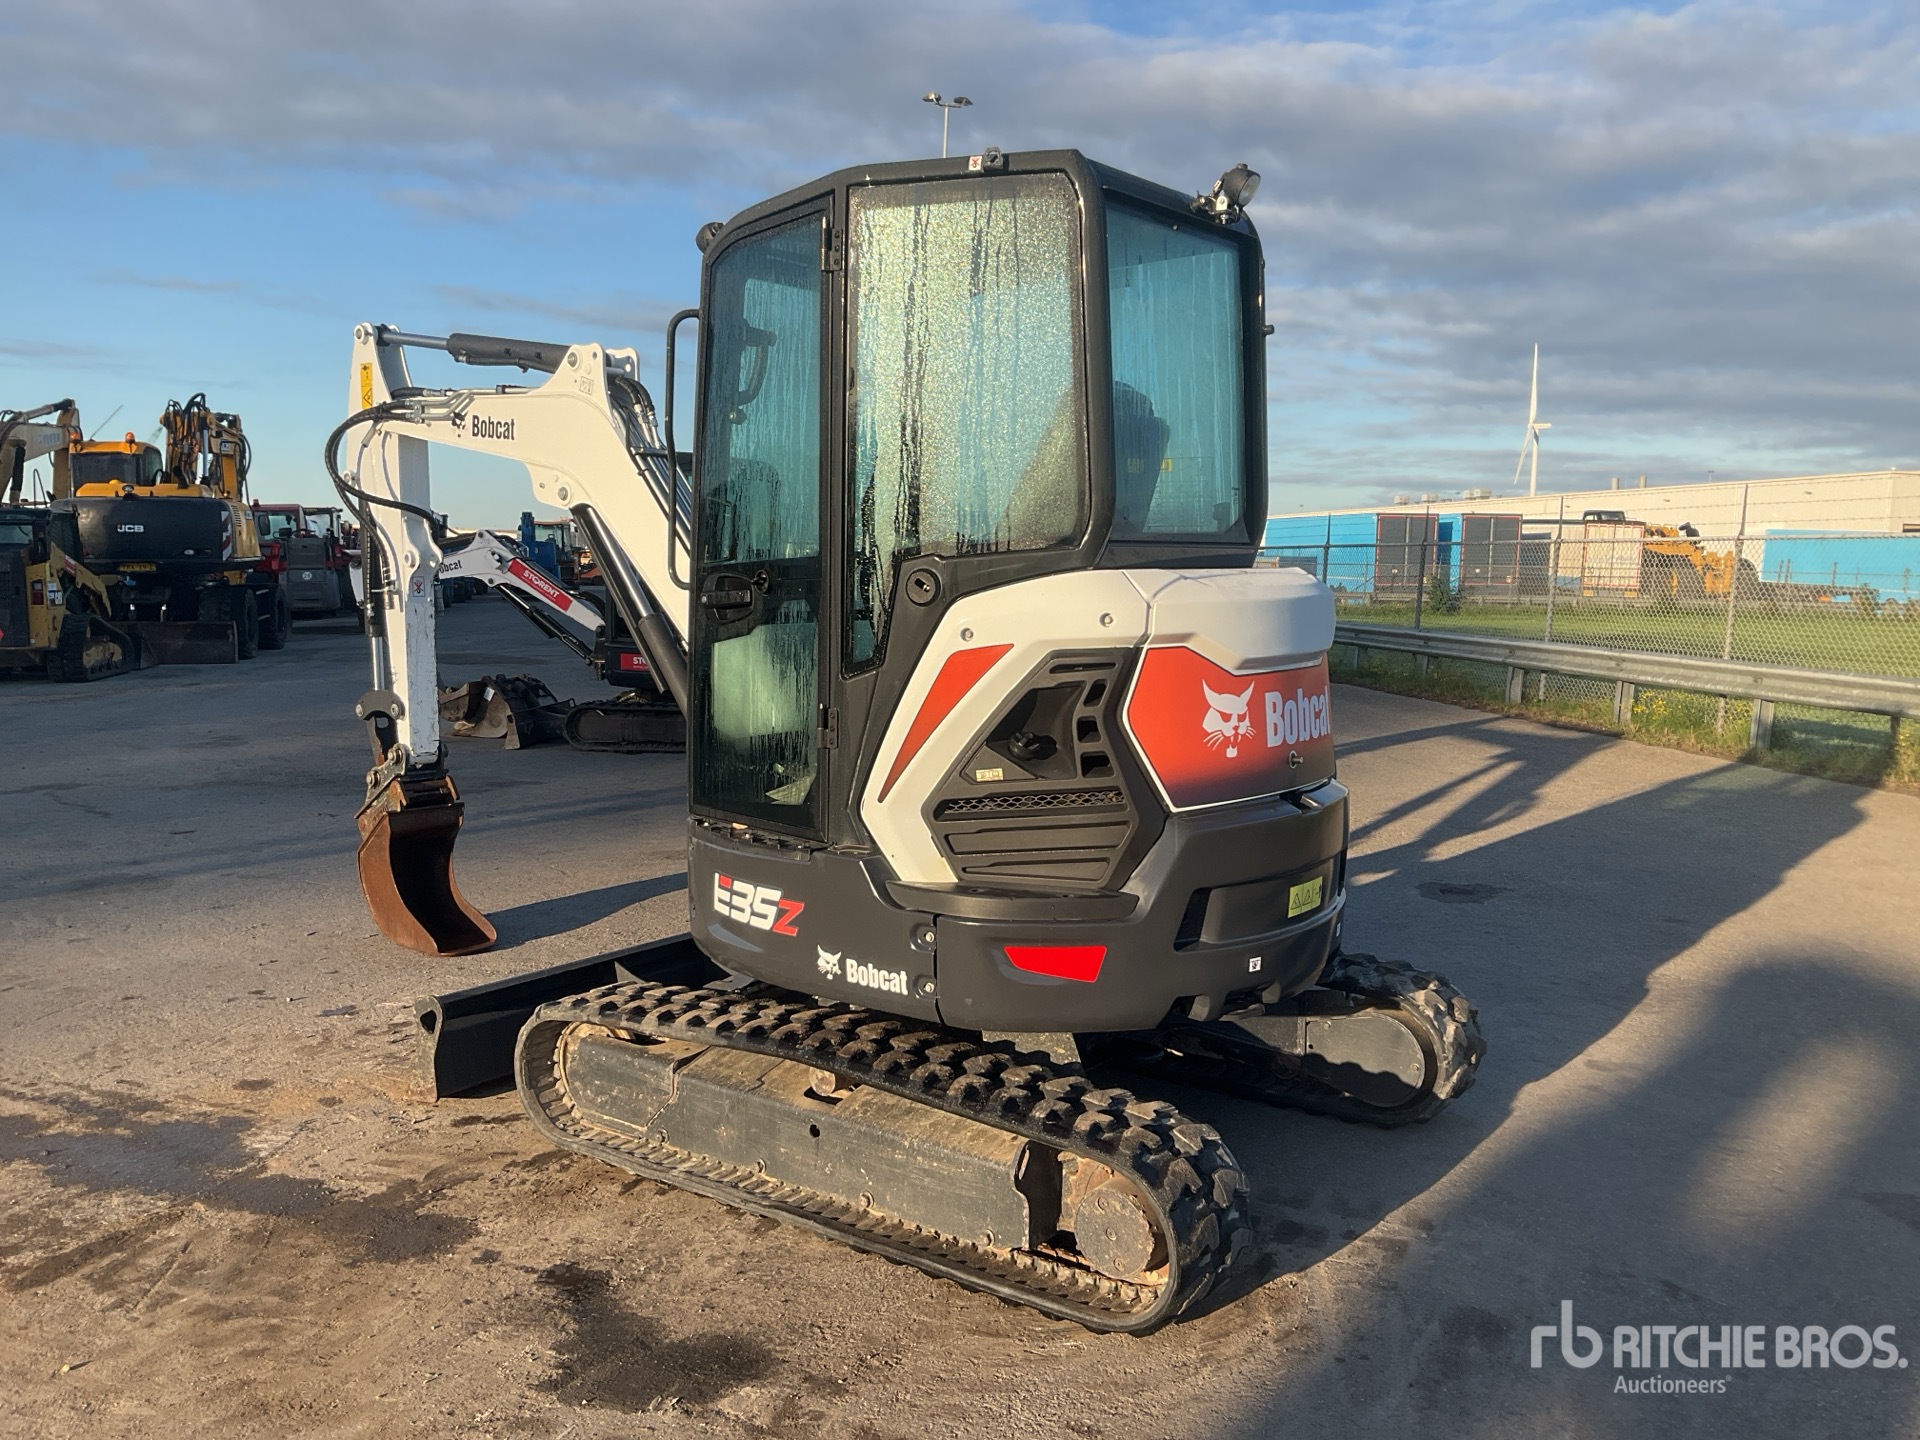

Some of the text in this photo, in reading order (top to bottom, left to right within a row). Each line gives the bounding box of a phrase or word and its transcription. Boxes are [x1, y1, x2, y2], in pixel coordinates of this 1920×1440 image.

[472, 414, 515, 441] Bobcat
[117, 524, 145, 533] JCB
[440, 559, 463, 574] obcat
[523, 569, 560, 598] STORENT
[713, 872, 806, 937] E35Z
[845, 958, 909, 996] Bobcat
